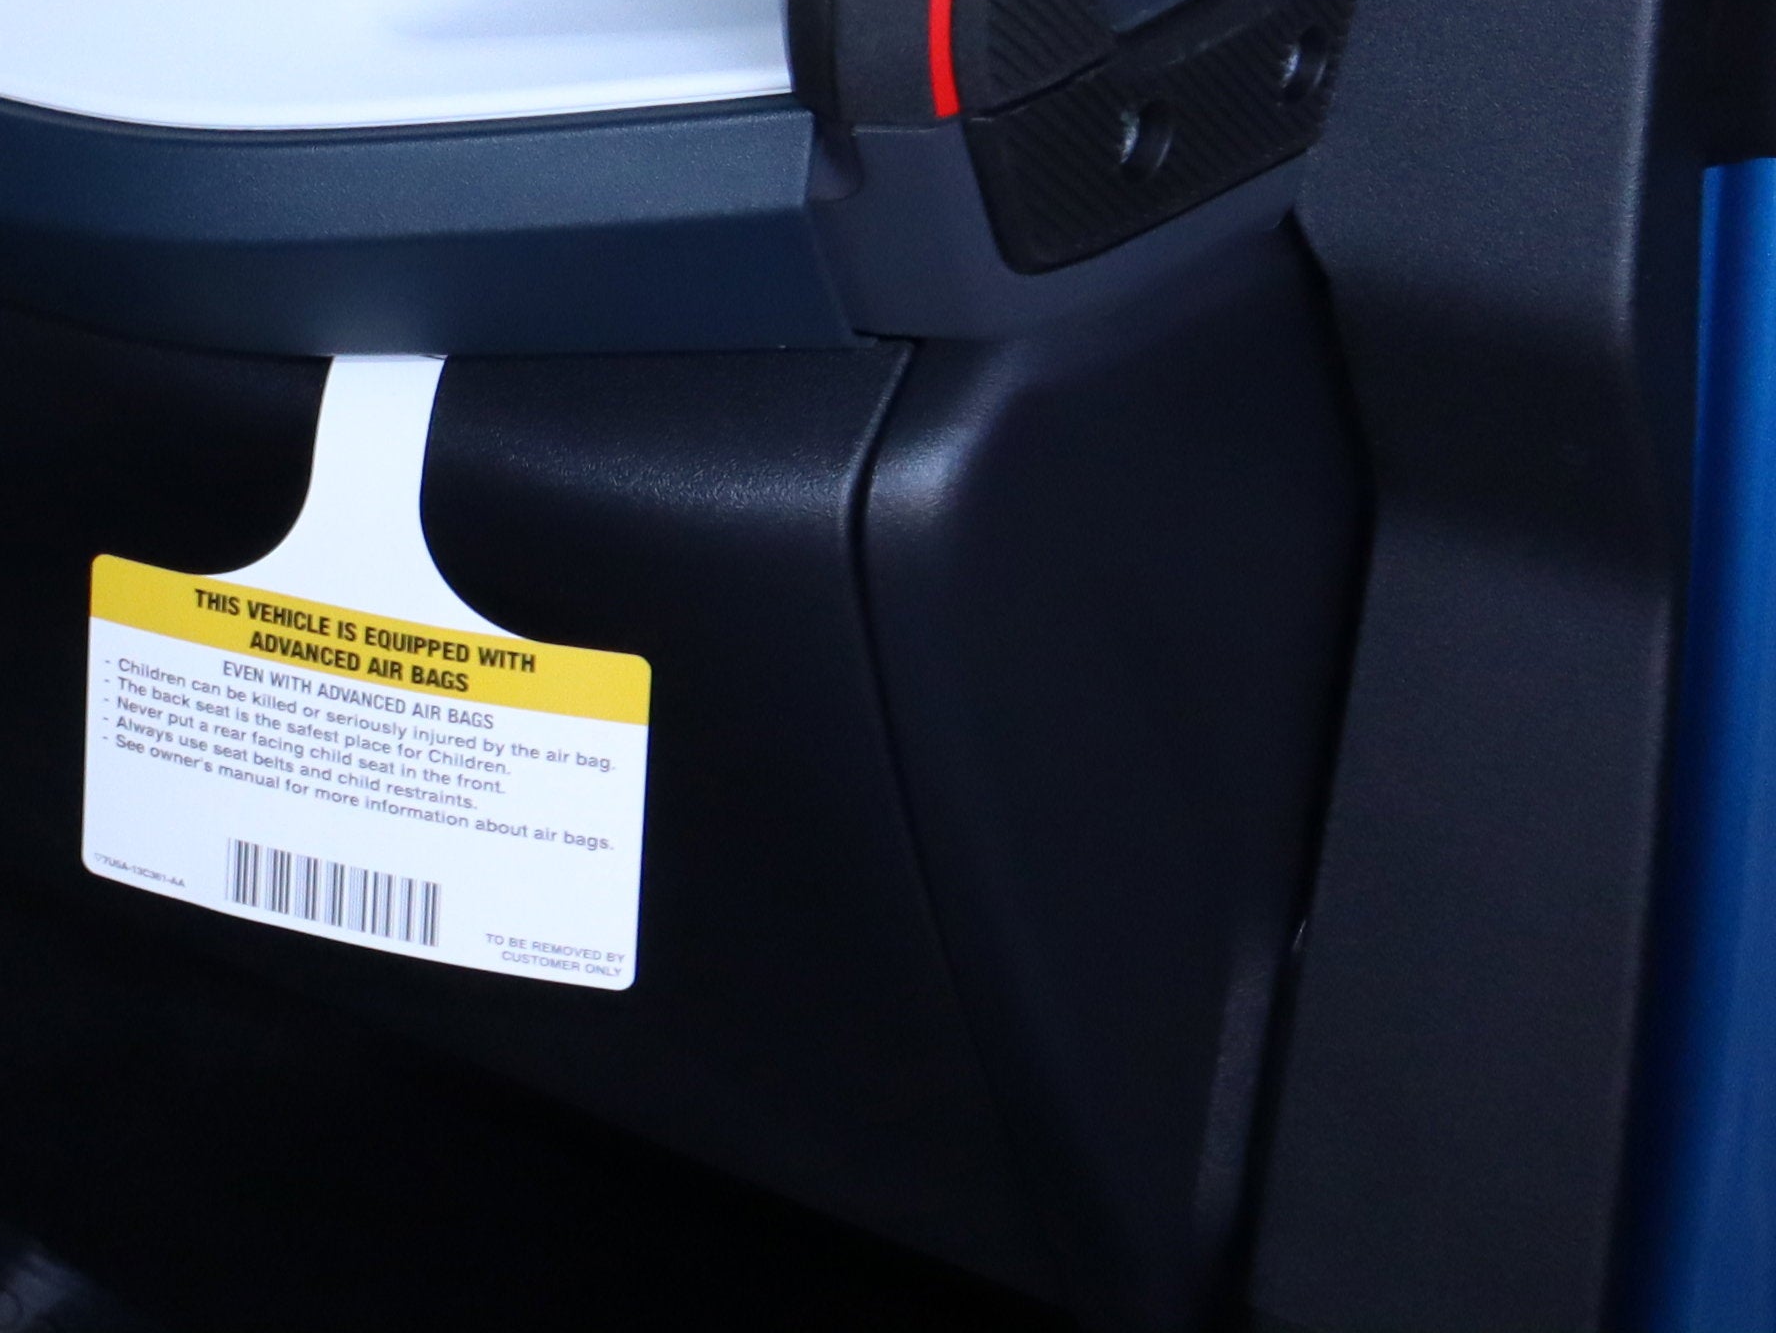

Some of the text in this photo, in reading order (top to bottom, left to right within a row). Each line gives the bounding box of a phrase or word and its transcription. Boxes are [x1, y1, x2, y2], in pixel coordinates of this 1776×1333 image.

[194, 588, 536, 673] THIS VEHICLE IS EQUIPPED WITH
[250, 631, 469, 692] ADVANCED AIR BAGS
[118, 657, 616, 772] Children can be killed or seriously injured by the air bag.
[118, 676, 512, 775] The back seat is the safest place for Children.
[223, 661, 494, 730] EVEN WITH ADVANCED AIR BAGS
[116, 697, 506, 794] Never put a rear facing child seat in the front.
[116, 716, 478, 809] Always use seat belts and child restraints.
[116, 734, 614, 851] See owner's manual for more information about air bags.
[486, 933, 625, 963] TO BE REMOVED BY
[501, 951, 622, 977] CUSTOMER ONLY
